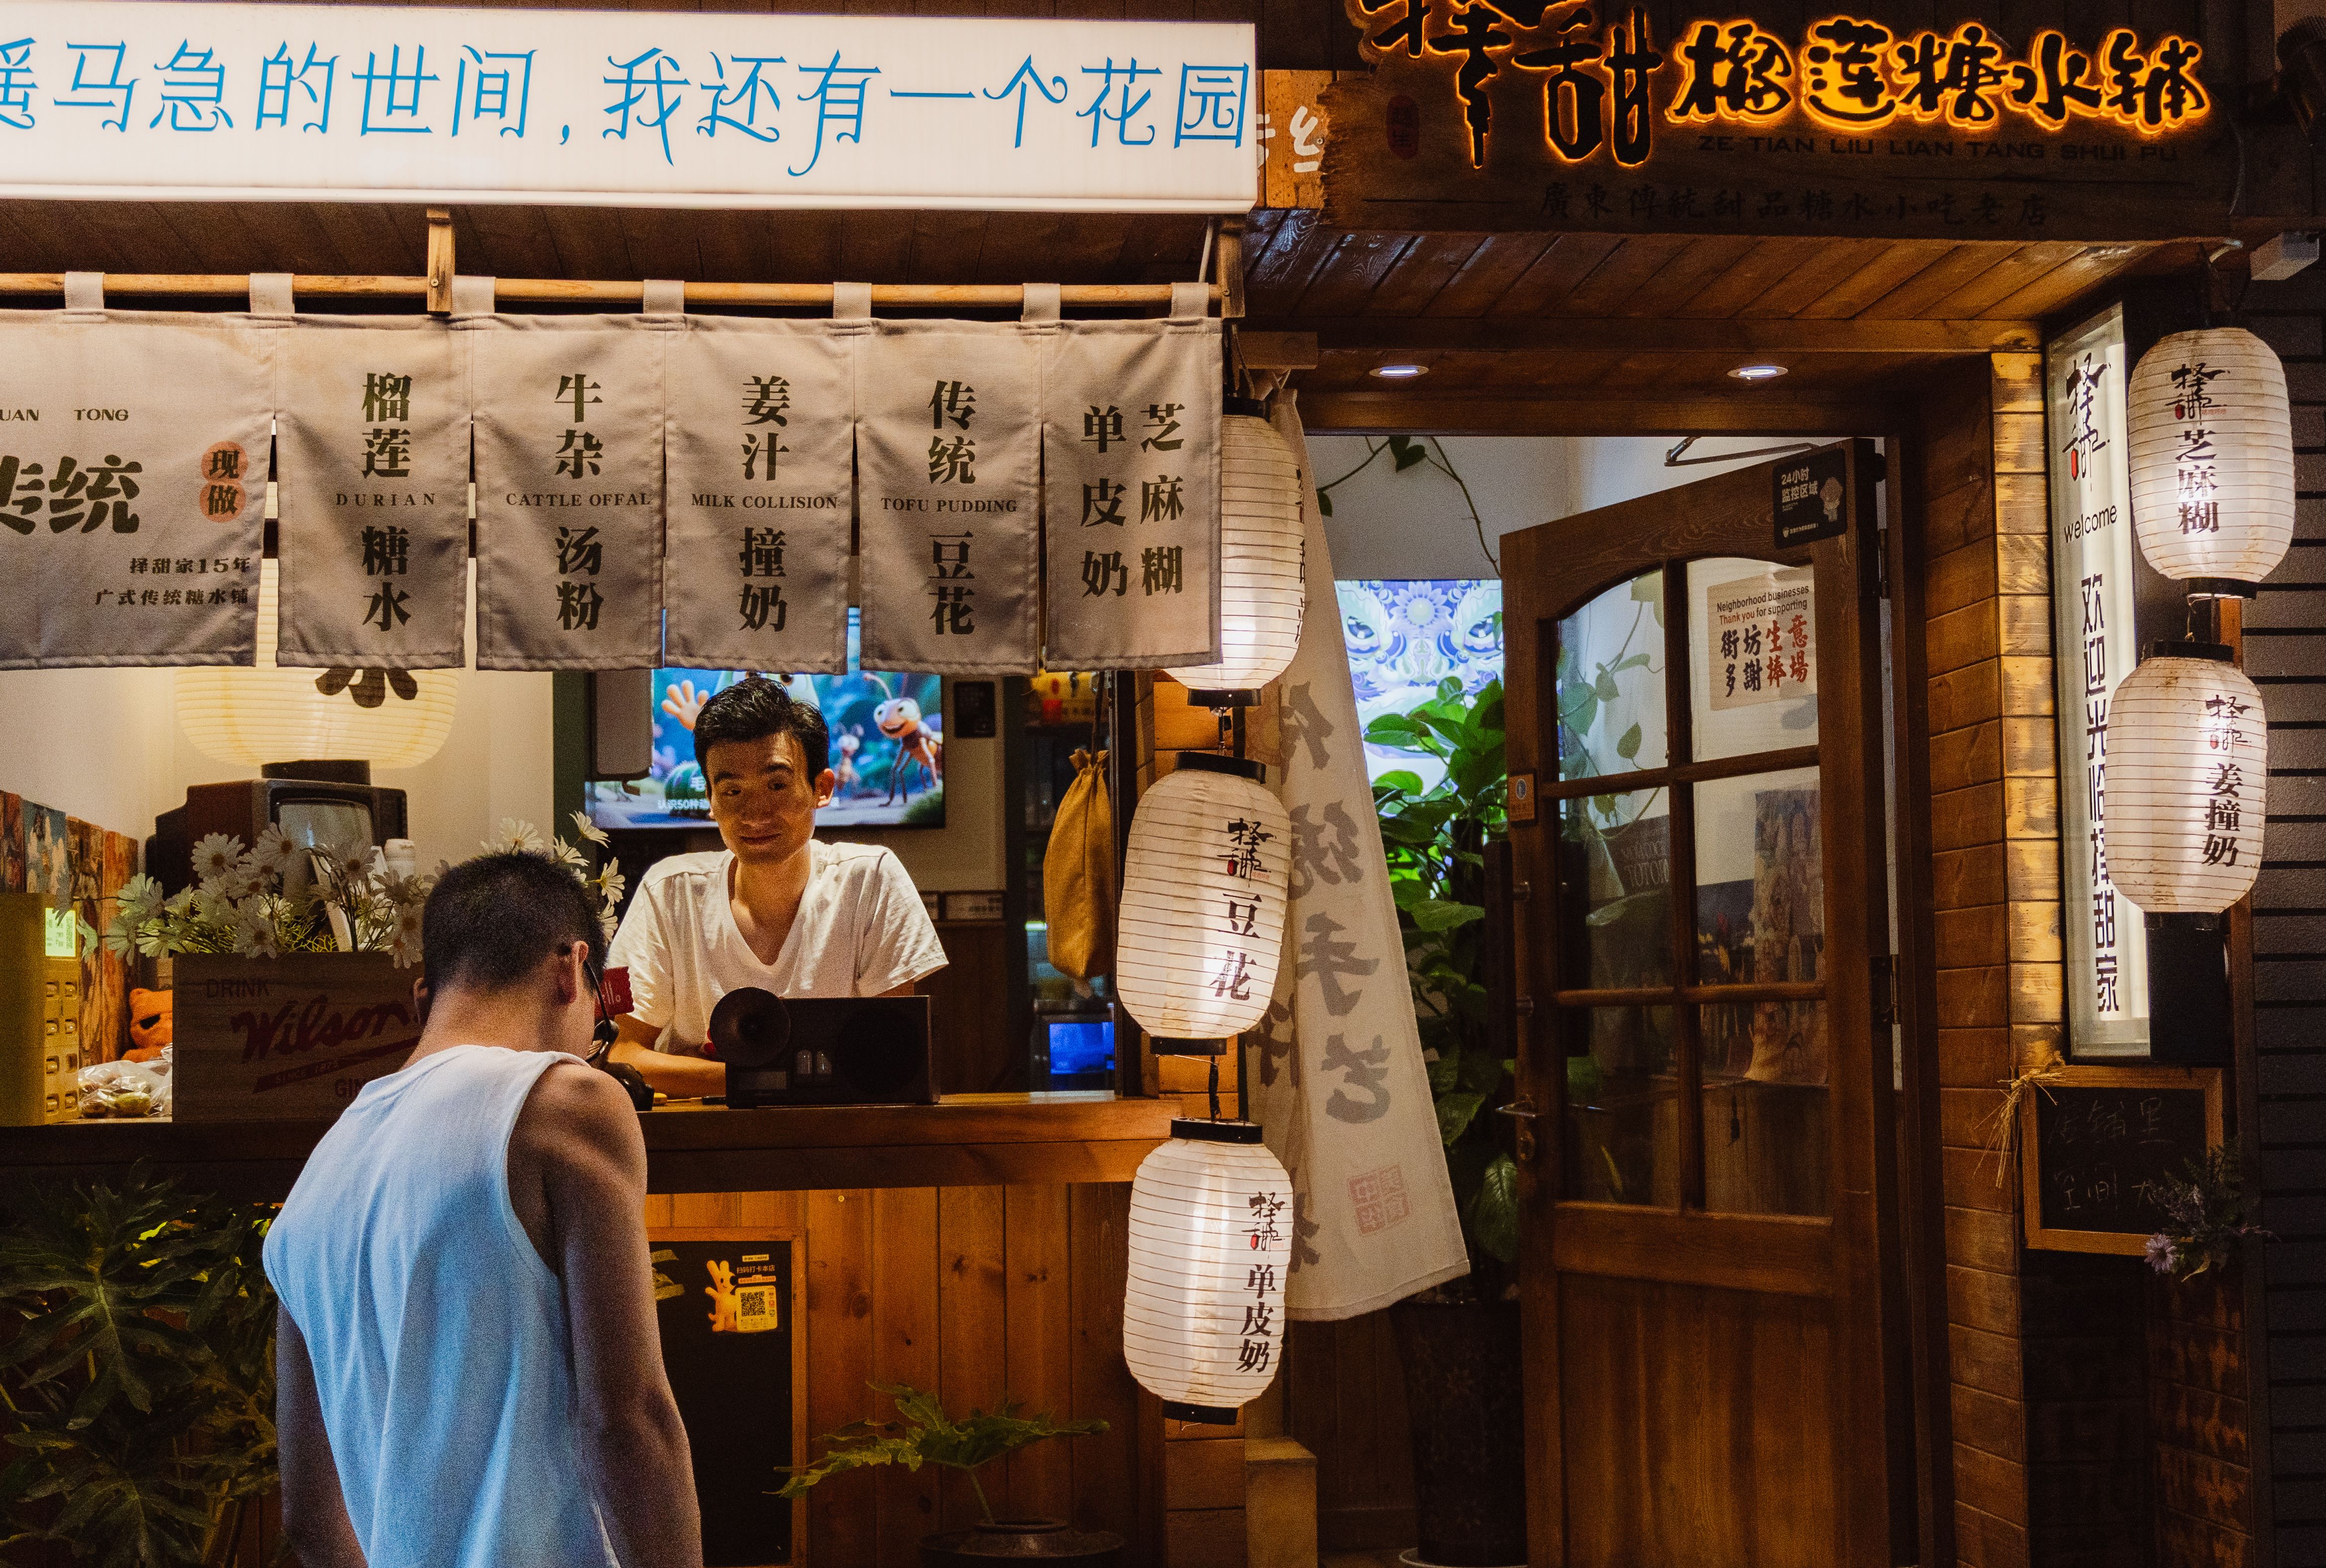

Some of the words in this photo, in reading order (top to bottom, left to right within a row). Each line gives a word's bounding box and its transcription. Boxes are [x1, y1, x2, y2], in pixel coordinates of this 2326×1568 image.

[1698, 136, 1735, 151] ZE
[1749, 137, 1814, 153] TIAN
[1830, 138, 1873, 154] LIU
[1889, 139, 1954, 156] LIAN
[1967, 141, 2044, 158] TANG
[2060, 144, 2127, 161] SHUI
[2140, 145, 2177, 162] PU
[74, 409, 129, 421] TONG
[207, 449, 241, 516] 现做
[2174, 429, 2220, 534] 芝麻糊
[336, 492, 436, 506] DURIAN
[506, 492, 582, 507] CATTLE
[589, 492, 651, 506] OFFAL
[691, 493, 735, 509] MILK
[742, 495, 838, 510] COLLISION
[880, 497, 929, 512] TOFU
[936, 498, 1017, 513] PUDDING
[1080, 405, 1127, 597] 单皮奶
[1140, 402, 1185, 596] 芝麻糊
[2064, 503, 2118, 544] welcome
[129, 557, 250, 575] 择甜家15年
[95, 588, 249, 606] 广式传统糖水铺
[1717, 592, 1766, 613] Neighborhood
[1768, 585, 1809, 601] businesses
[1719, 611, 1741, 625] Thank
[1742, 609, 1755, 623] you
[1756, 606, 1766, 617] for
[1767, 599, 1807, 615] supporting
[2201, 763, 2244, 868] 姜撞奶
[1209, 891, 1262, 1001] 豆花
[205, 979, 270, 998] DRINK
[736, 1264, 775, 1274] 扫码打卡本店
[1235, 1264, 1276, 1374] 单皮奶
